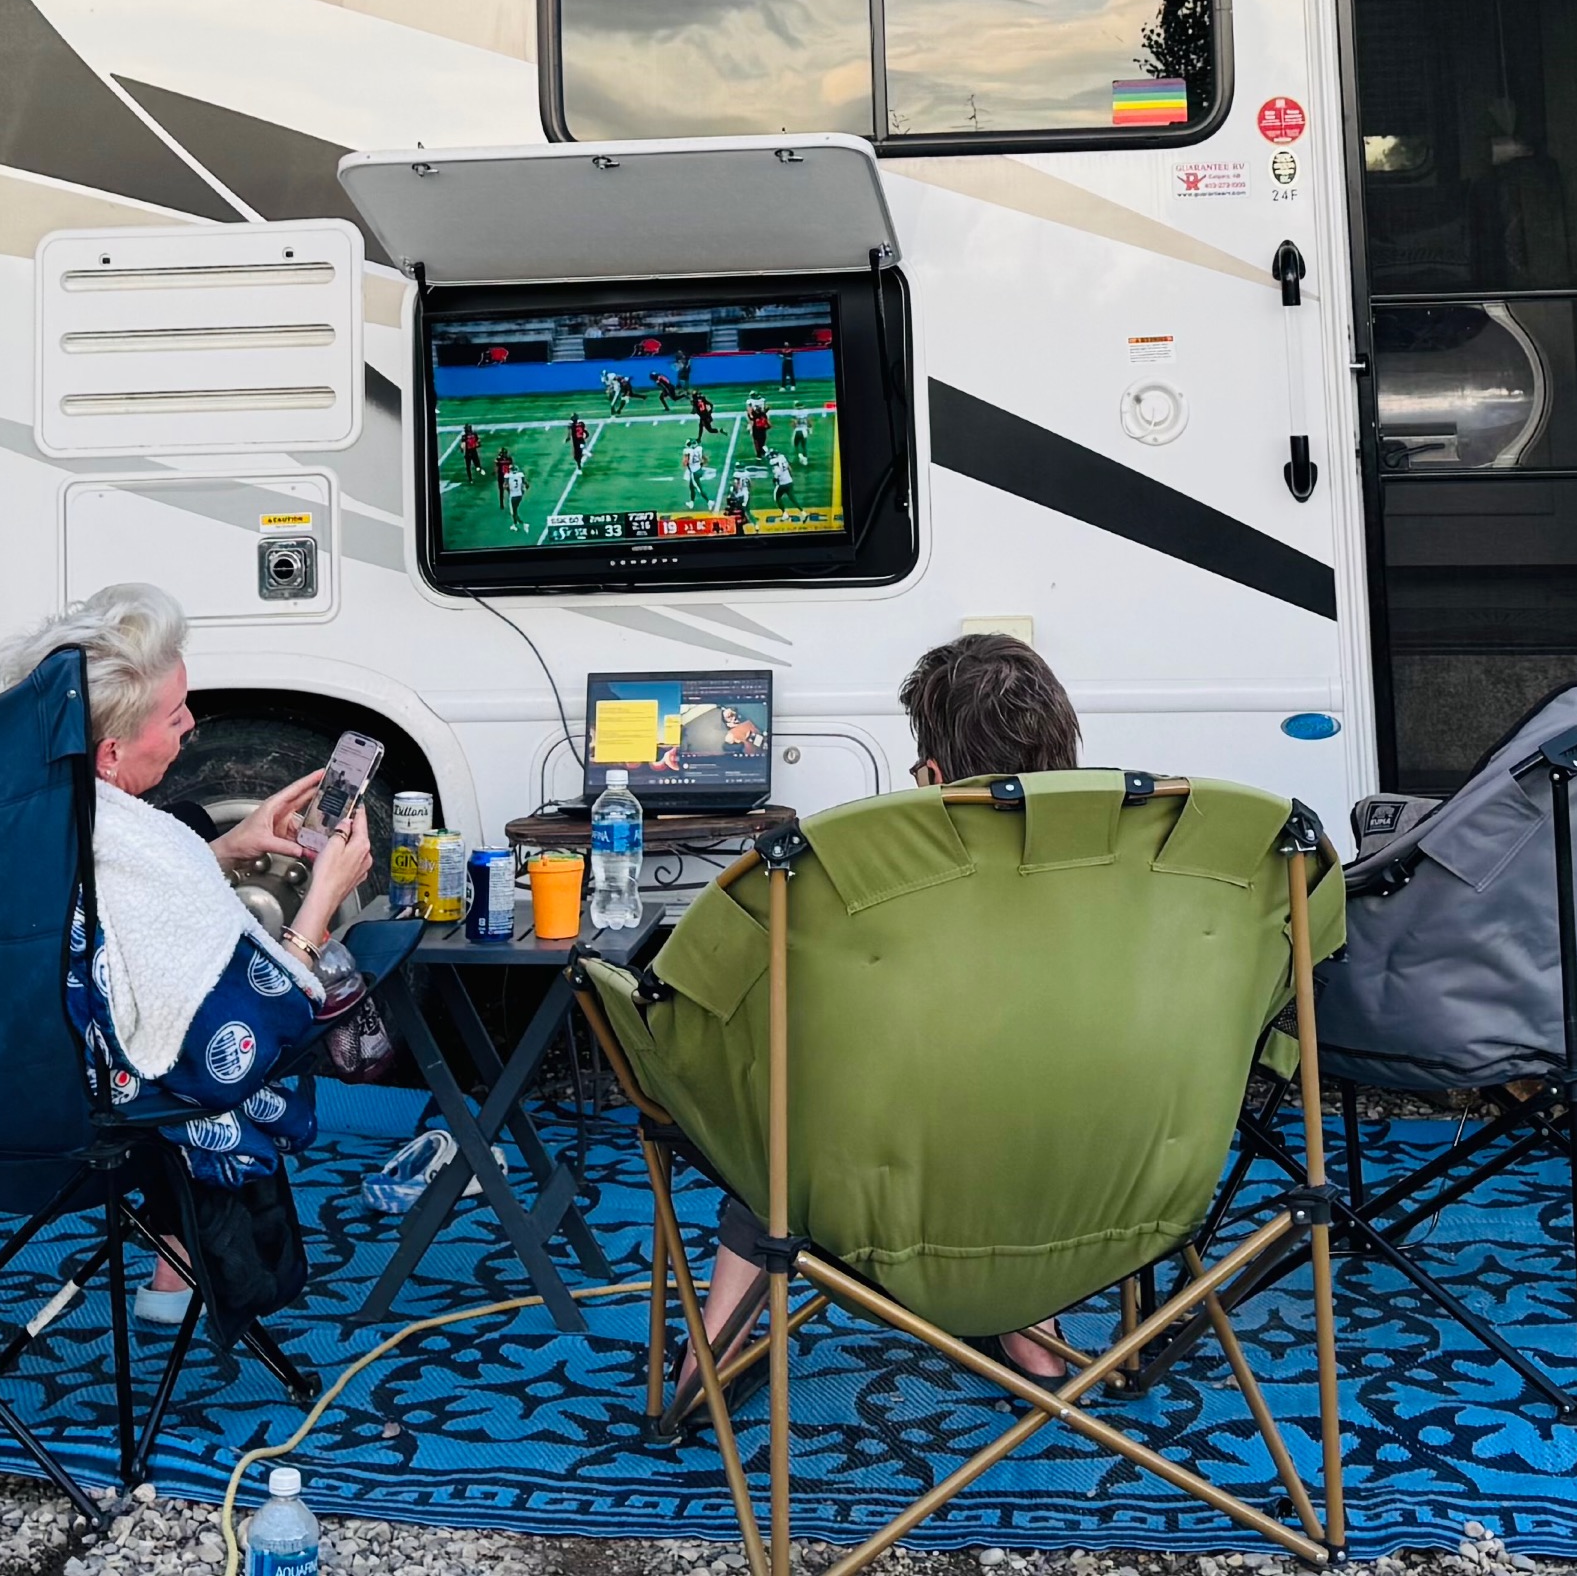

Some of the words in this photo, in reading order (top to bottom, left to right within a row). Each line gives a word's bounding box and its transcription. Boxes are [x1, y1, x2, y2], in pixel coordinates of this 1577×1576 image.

[1272, 189, 1298, 201] 24F
[604, 525, 623, 537] 33
[663, 522, 678, 534] 19
[395, 854, 419, 868] GIN
[209, 1030, 242, 1079] OILERS
